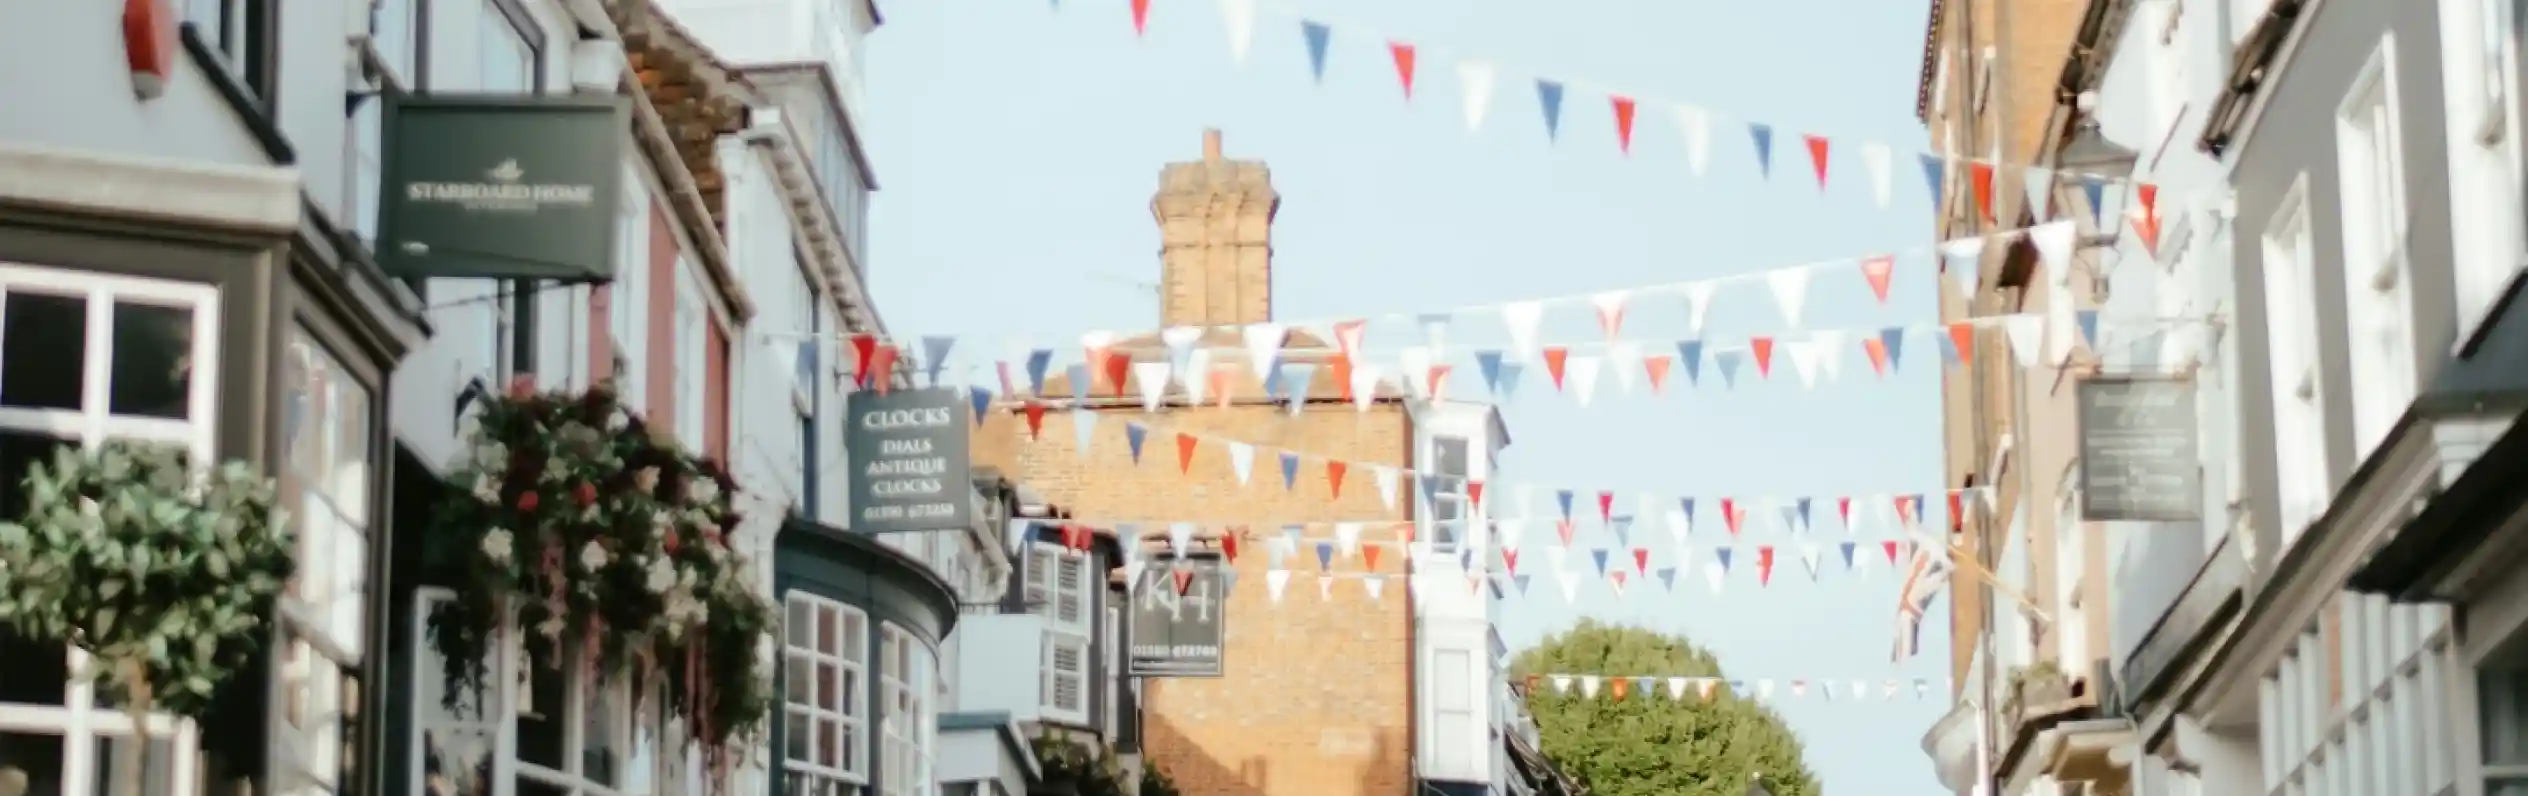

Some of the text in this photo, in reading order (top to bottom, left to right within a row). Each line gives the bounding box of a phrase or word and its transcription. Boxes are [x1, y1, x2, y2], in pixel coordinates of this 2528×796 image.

[407, 183, 594, 202] STARBOARD HOME
[864, 407, 949, 427] CLOCKS
[882, 439, 932, 453] DIALS
[866, 458, 945, 475] ANTIQUE
[872, 479, 942, 495] CLOCKS
